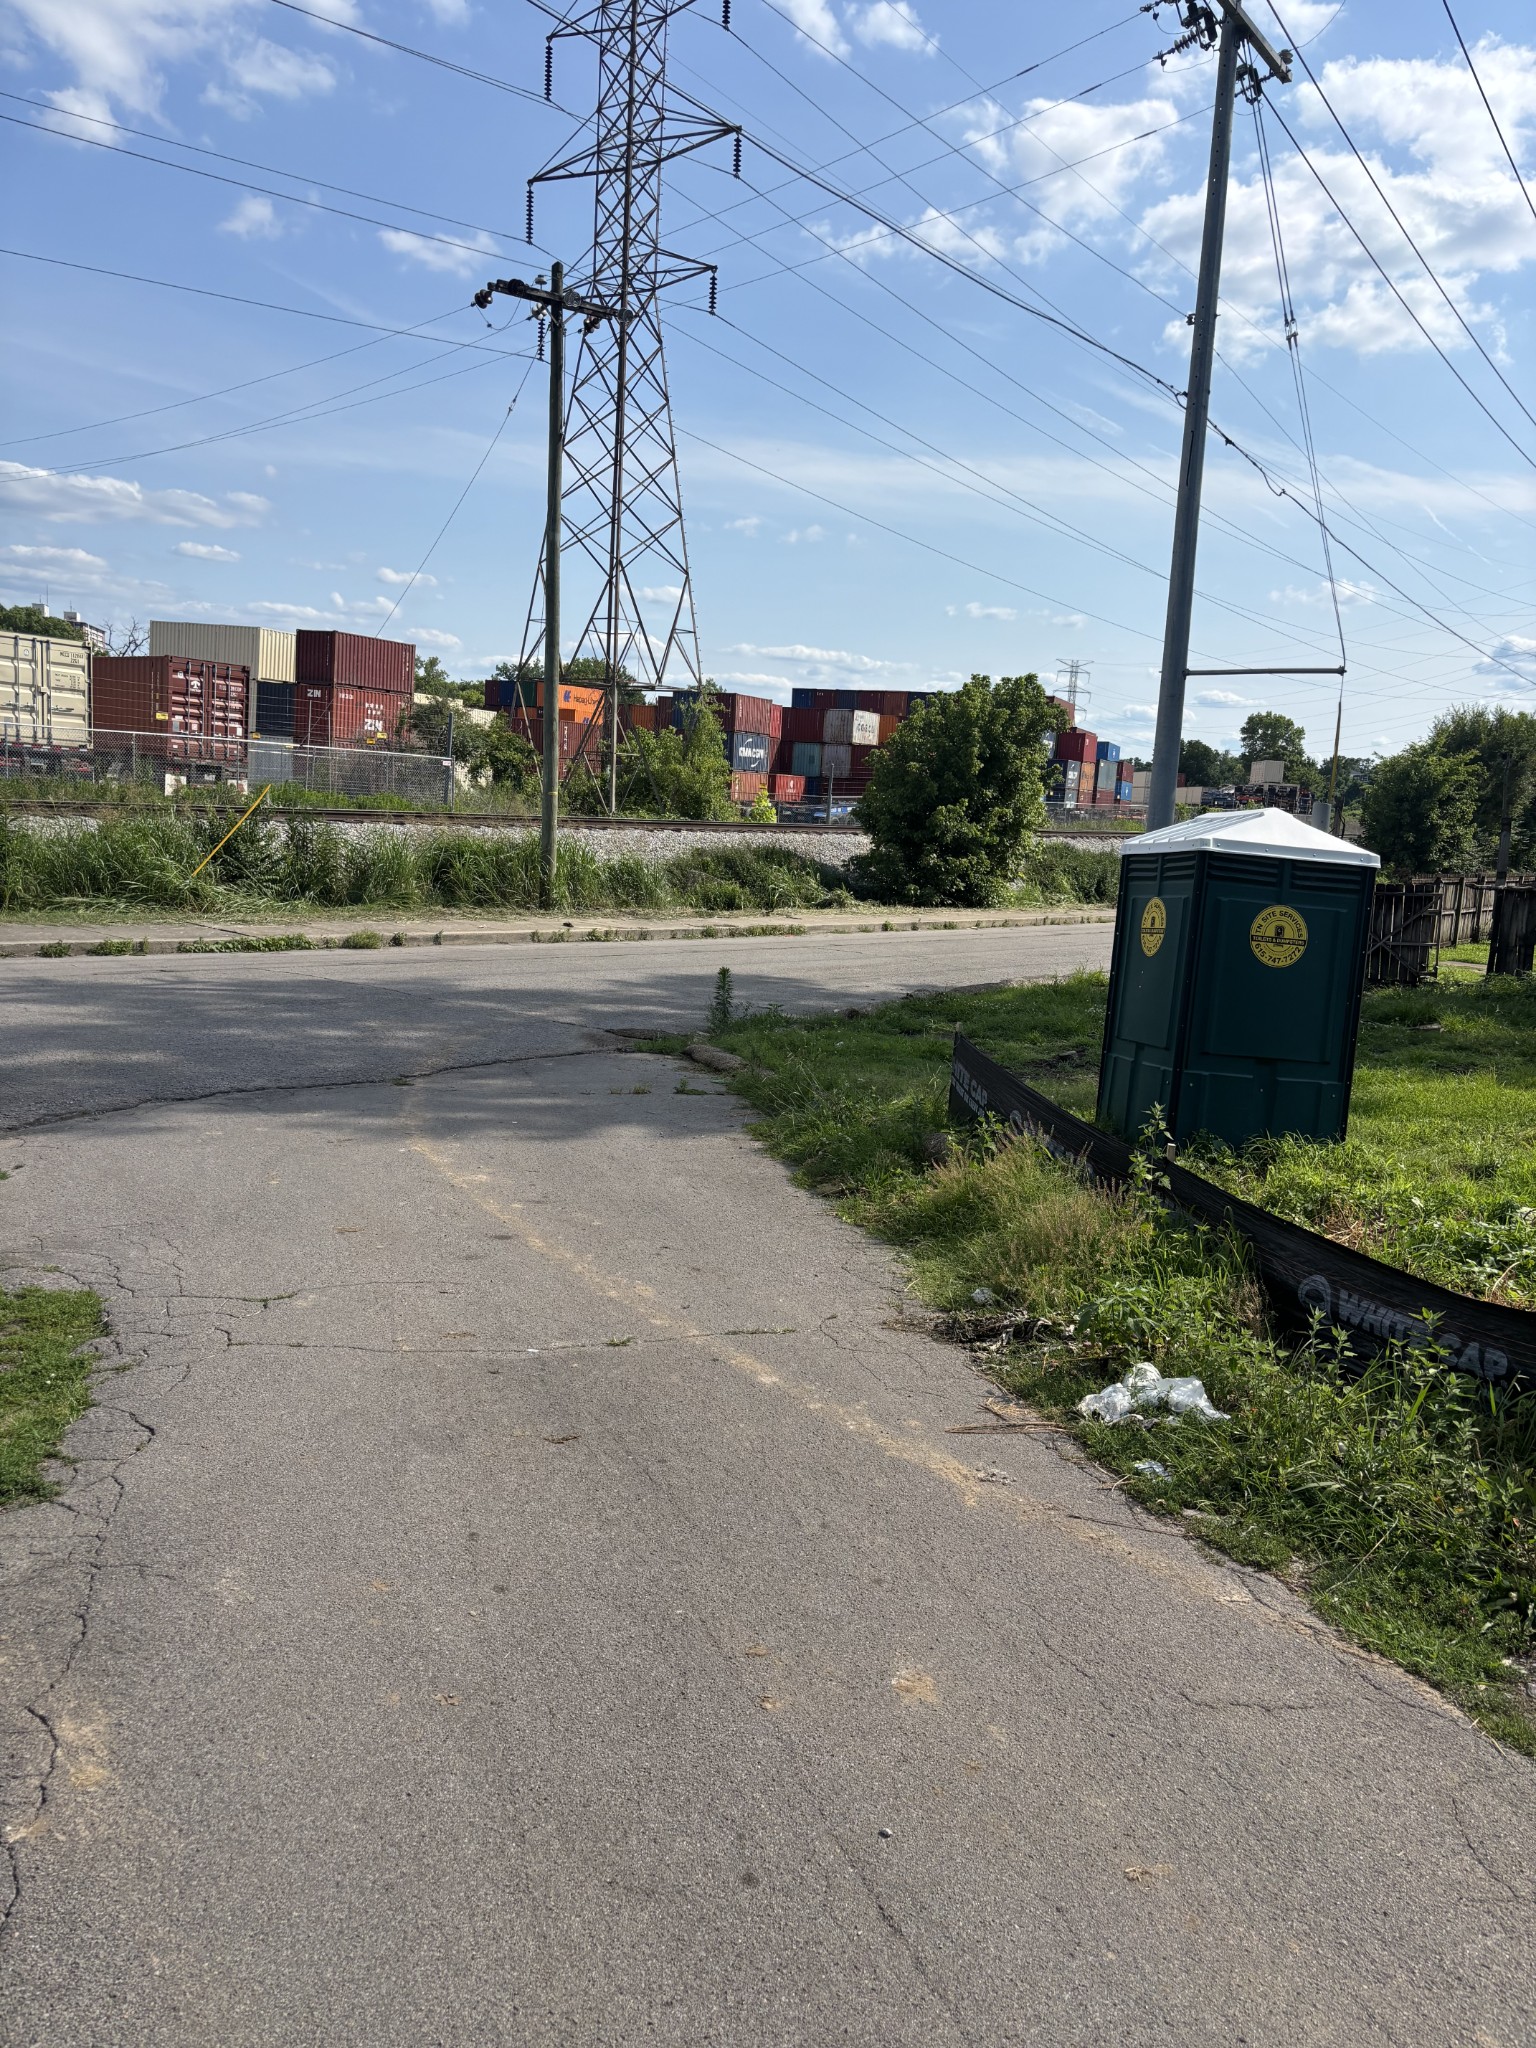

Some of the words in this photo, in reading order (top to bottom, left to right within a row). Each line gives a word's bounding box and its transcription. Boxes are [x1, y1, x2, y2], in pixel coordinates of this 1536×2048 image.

[1255, 923, 1264, 934] TN
[1261, 910, 1277, 923] SITE
[1279, 910, 1304, 939] SERVICES
[1254, 942, 1302, 964] 615-747-7272
